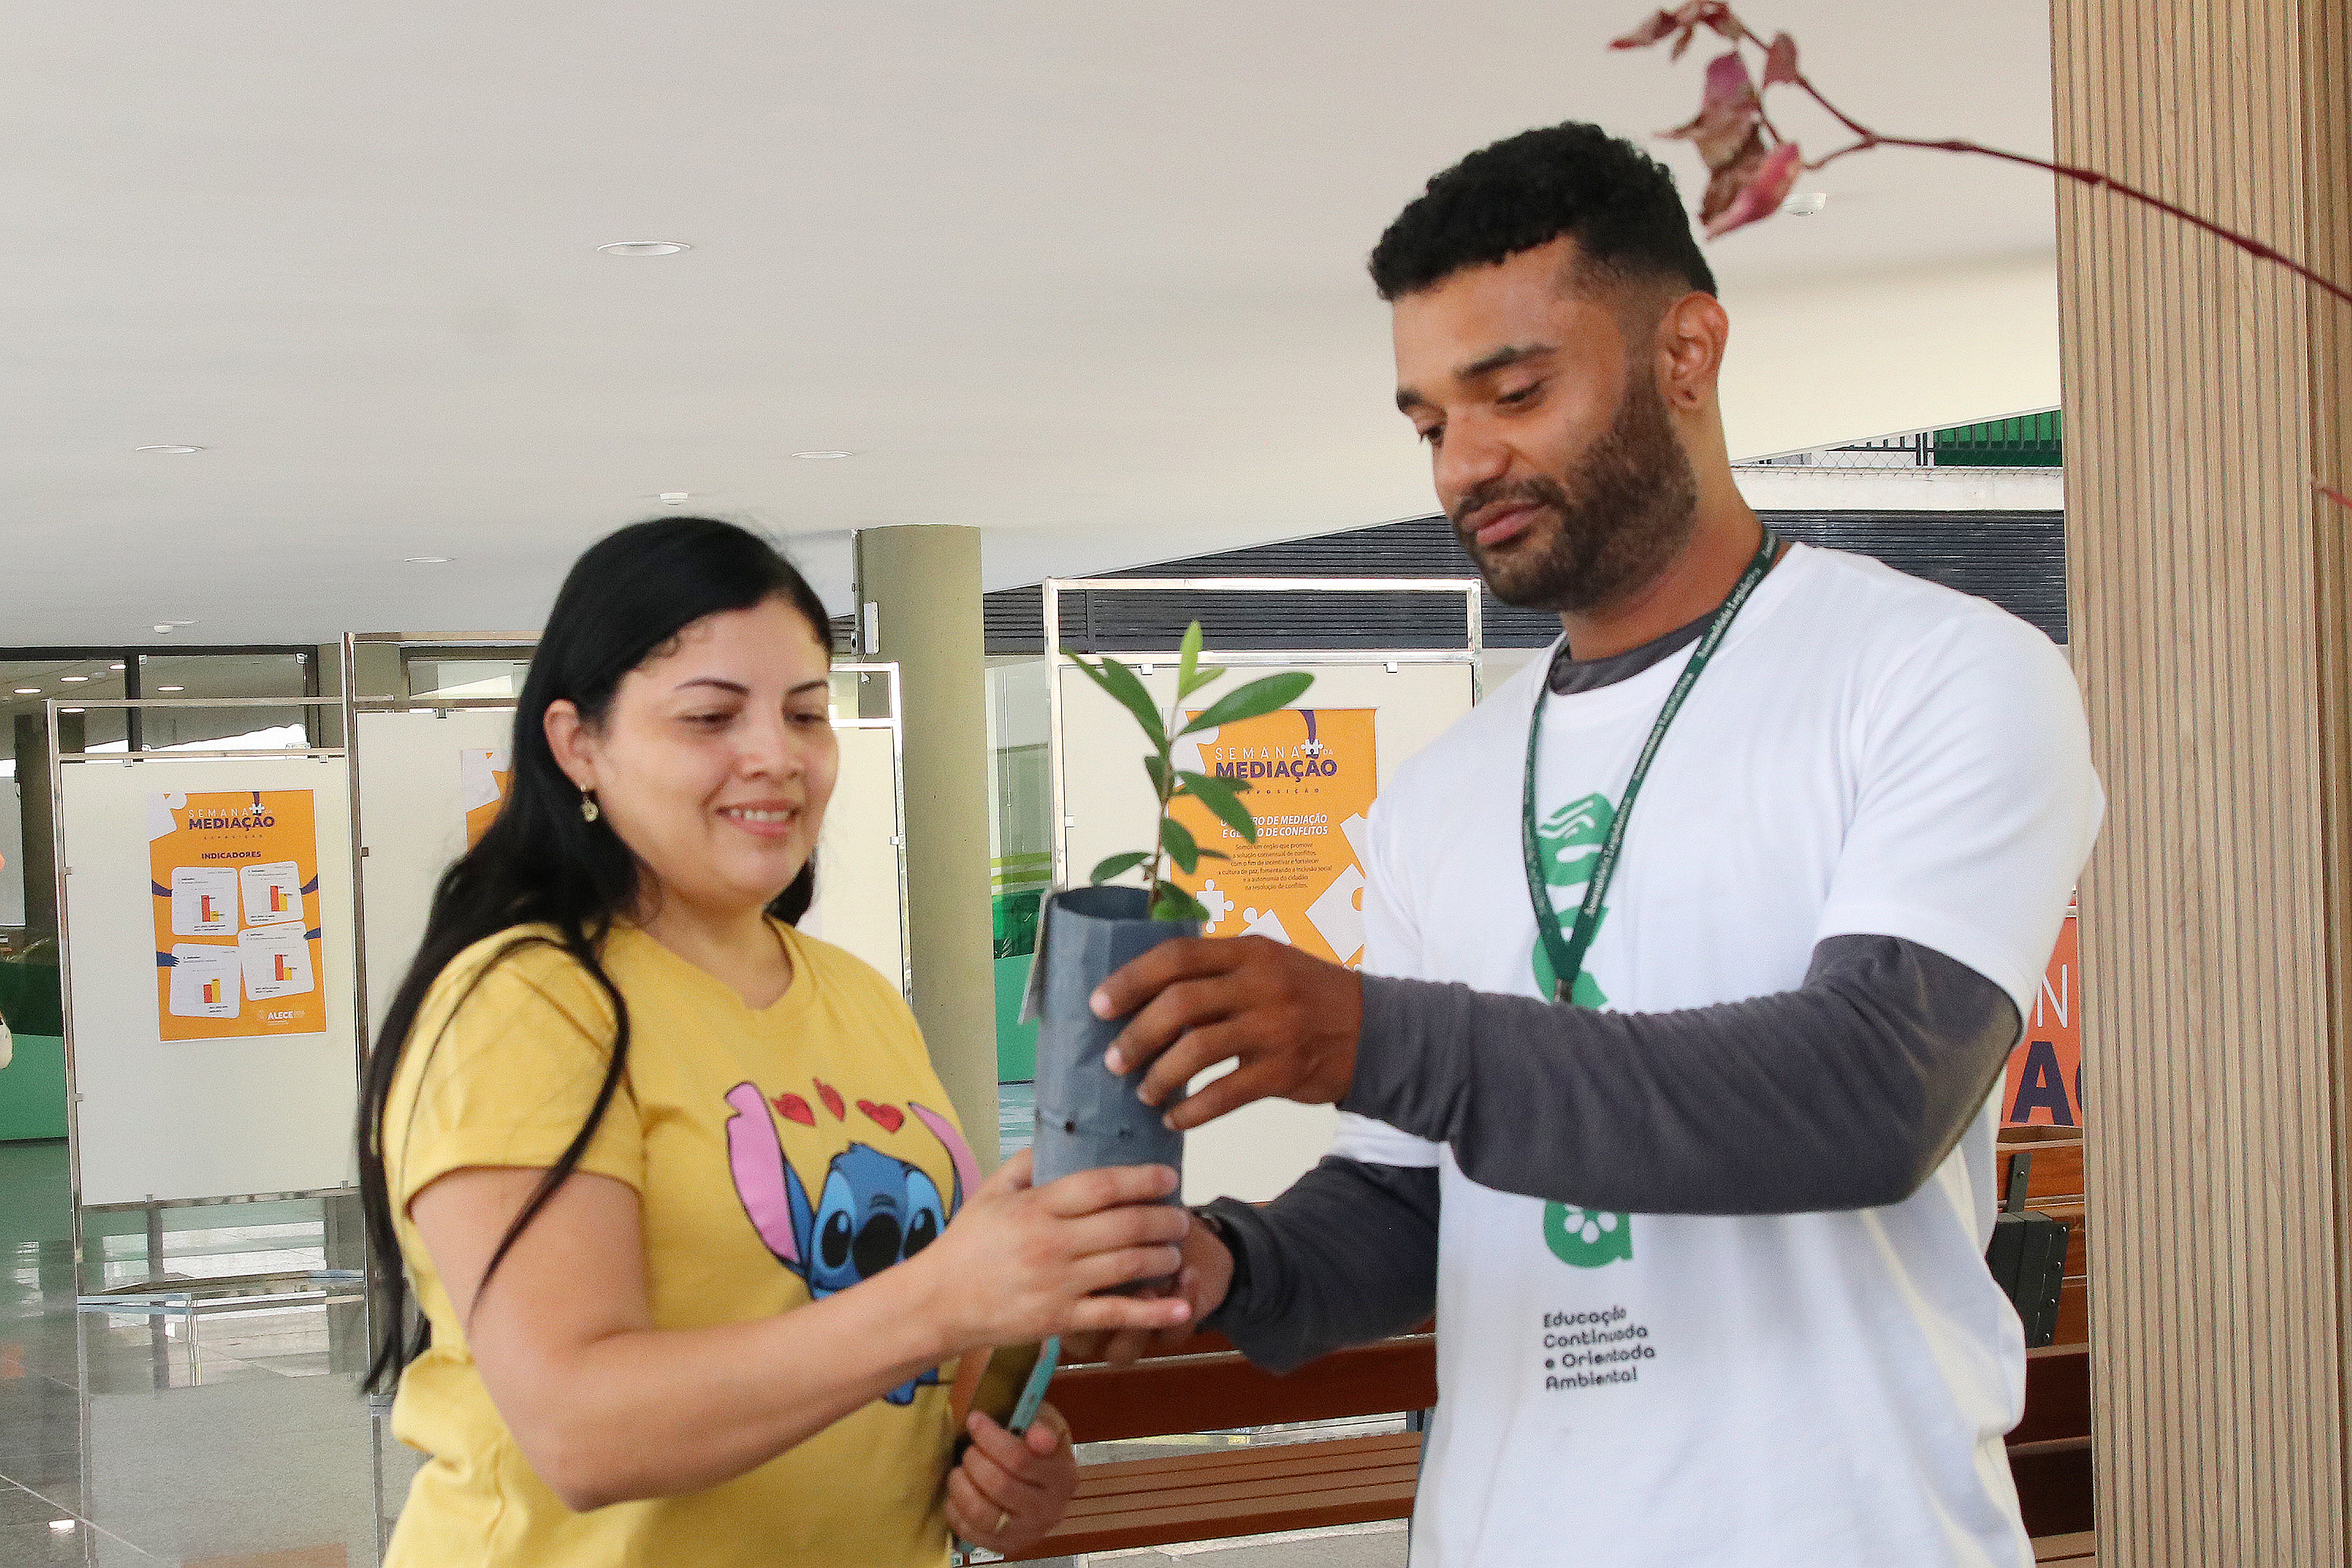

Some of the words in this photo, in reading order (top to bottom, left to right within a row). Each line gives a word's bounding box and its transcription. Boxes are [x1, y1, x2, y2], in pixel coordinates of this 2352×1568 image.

[1215, 746, 1300, 760] SEMANA
[1216, 754, 1338, 783] MEDIAÇÃO
[188, 808, 249, 818] SEMANA
[1266, 816, 1279, 825] DE
[1280, 813, 1328, 826] MEDIAÇÃO
[189, 816, 275, 832] MEDIAÇÃO
[1222, 829, 1228, 838] E
[1266, 827, 1278, 837] DE
[1279, 826, 1328, 836] CONFLITOS
[201, 851, 261, 859] INDICADORES
[267, 1011, 293, 1020] ALECE
[1543, 1304, 1628, 1328] Educação
[1546, 1366, 1637, 1390] Ambiental
